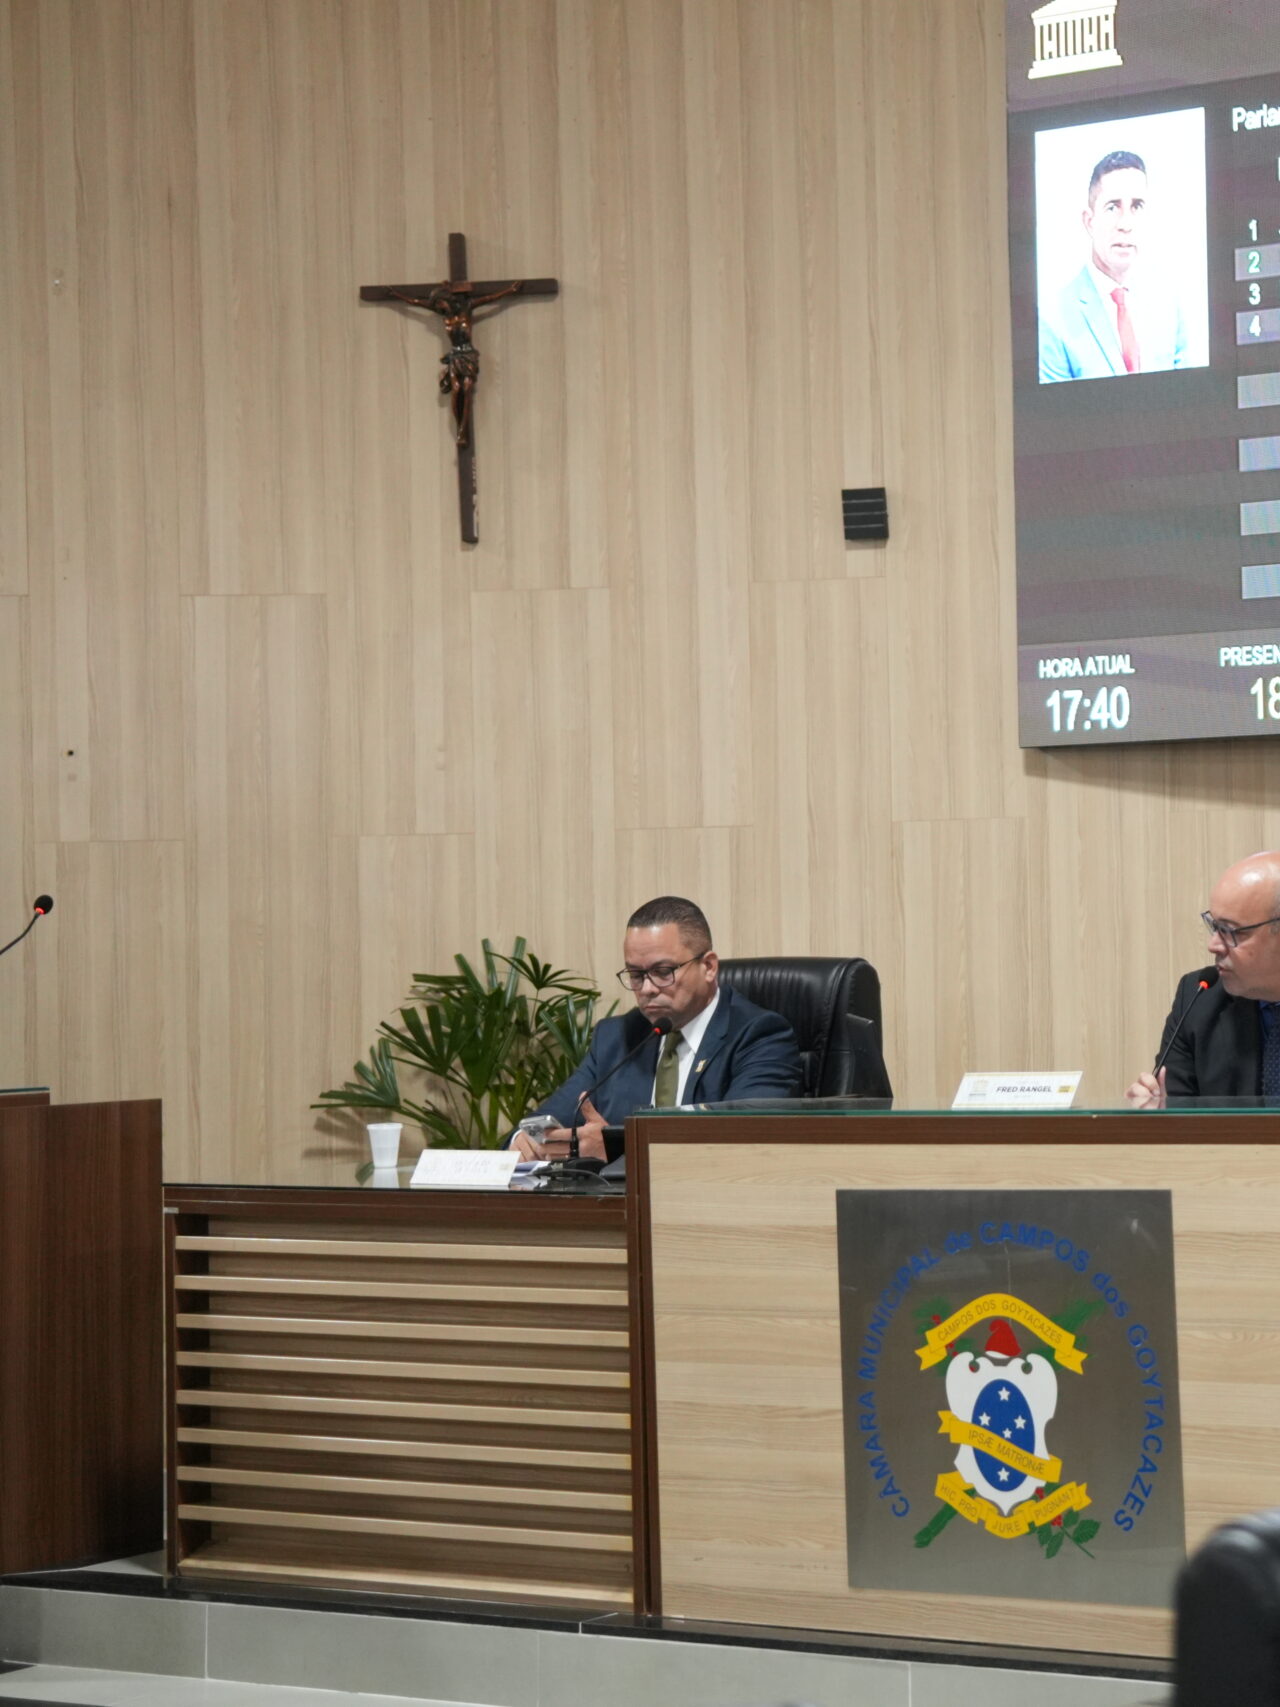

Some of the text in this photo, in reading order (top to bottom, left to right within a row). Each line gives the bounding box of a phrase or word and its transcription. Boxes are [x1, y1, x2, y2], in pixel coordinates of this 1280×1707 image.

[1249, 219, 1258, 241] 1
[1248, 251, 1261, 273] 2
[1248, 283, 1261, 305] 3
[1249, 314, 1262, 337] 4
[1038, 654, 1135, 679] HORA ATUAL
[1046, 685, 1130, 733] 17:40
[1019, 1085, 1052, 1093] RANGEL
[937, 1299, 1063, 1345] CAMPOS DOS GOYTACAZES
[857, 1247, 942, 1381] MUNICIPAL
[944, 1231, 973, 1255] de
[978, 1221, 1091, 1272] CAMPOS
[1091, 1272, 1130, 1319] dos
[1113, 1323, 1166, 1532] GOYTACAZES
[940, 1482, 1076, 1534] HIC PRO JURE PUGNANT
